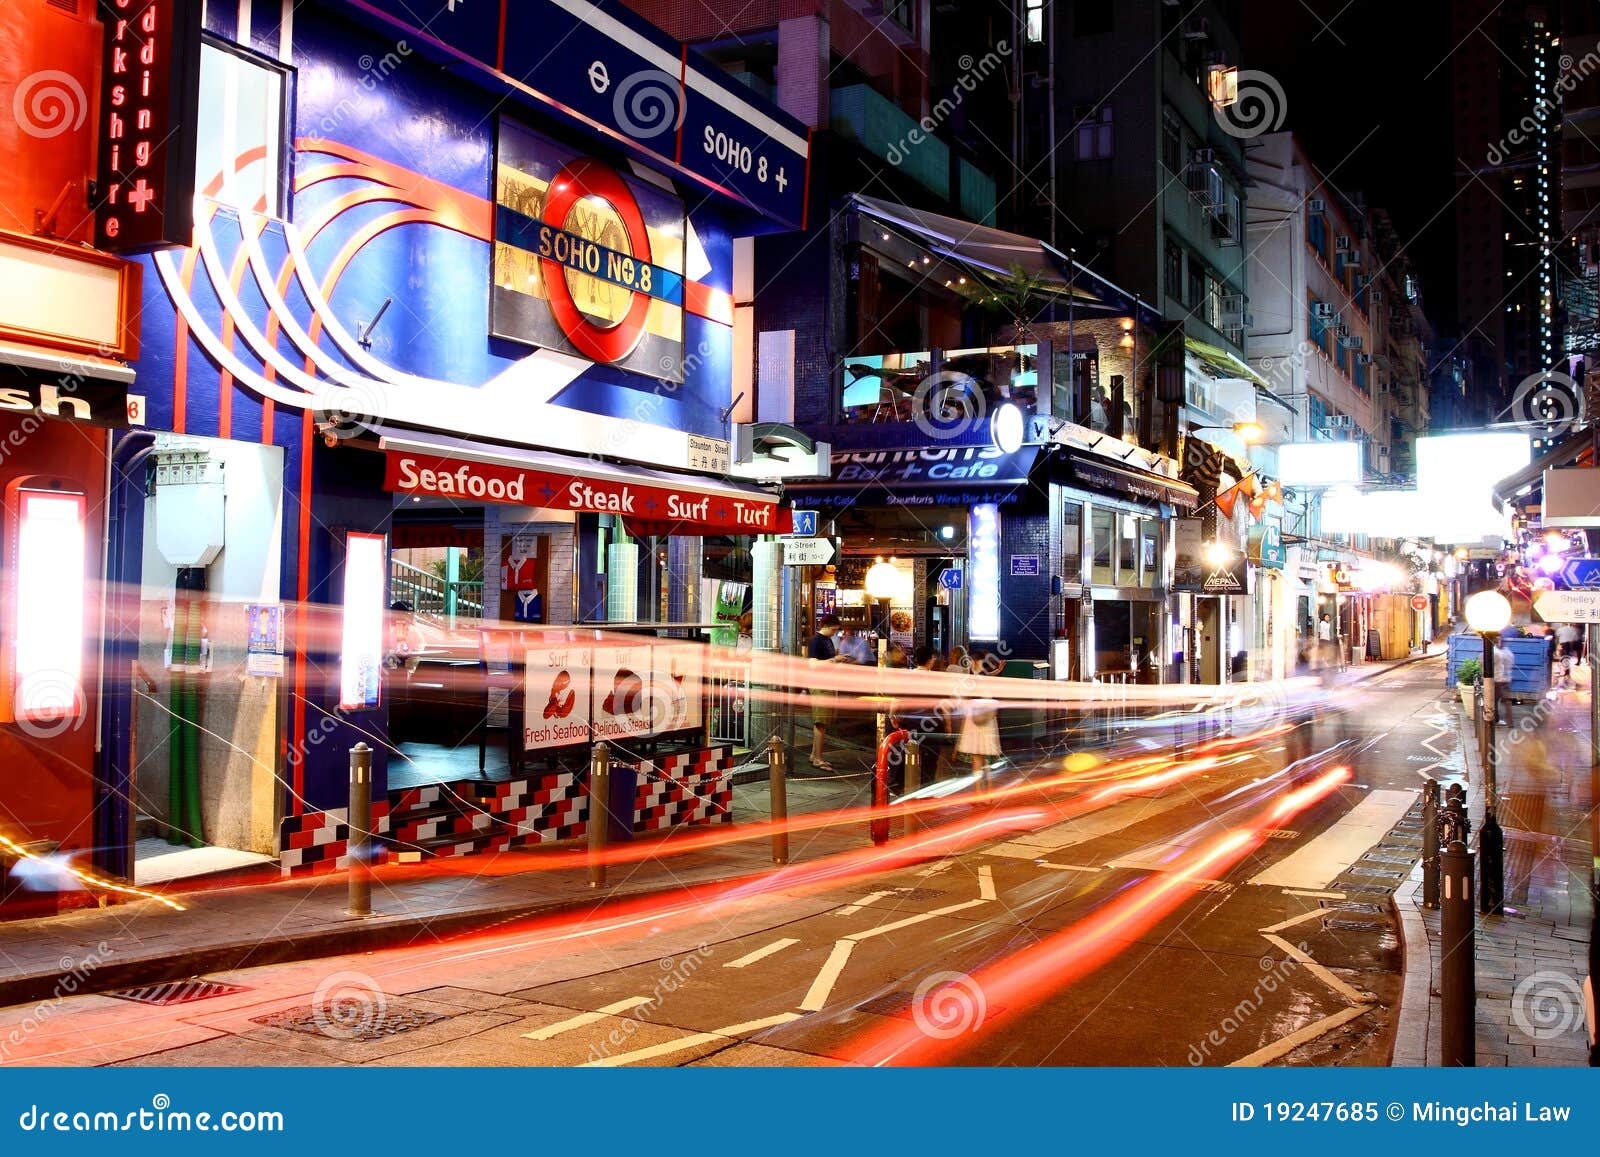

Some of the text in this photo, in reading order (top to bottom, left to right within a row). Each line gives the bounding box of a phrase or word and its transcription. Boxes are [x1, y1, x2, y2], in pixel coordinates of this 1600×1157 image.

[703, 125, 752, 174] SOHO
[757, 156, 768, 183] 8
[539, 226, 599, 273] SOHO
[398, 458, 525, 501] Seafood
[927, 460, 999, 479] Cafe
[568, 481, 635, 513] Steak
[667, 494, 710, 521] Surf
[733, 502, 770, 527] Turf
[794, 541, 816, 549] Street
[548, 650, 569, 668] Surf
[525, 720, 590, 743] Fresh Seafood
[593, 718, 651, 737] Delicious Steaks
